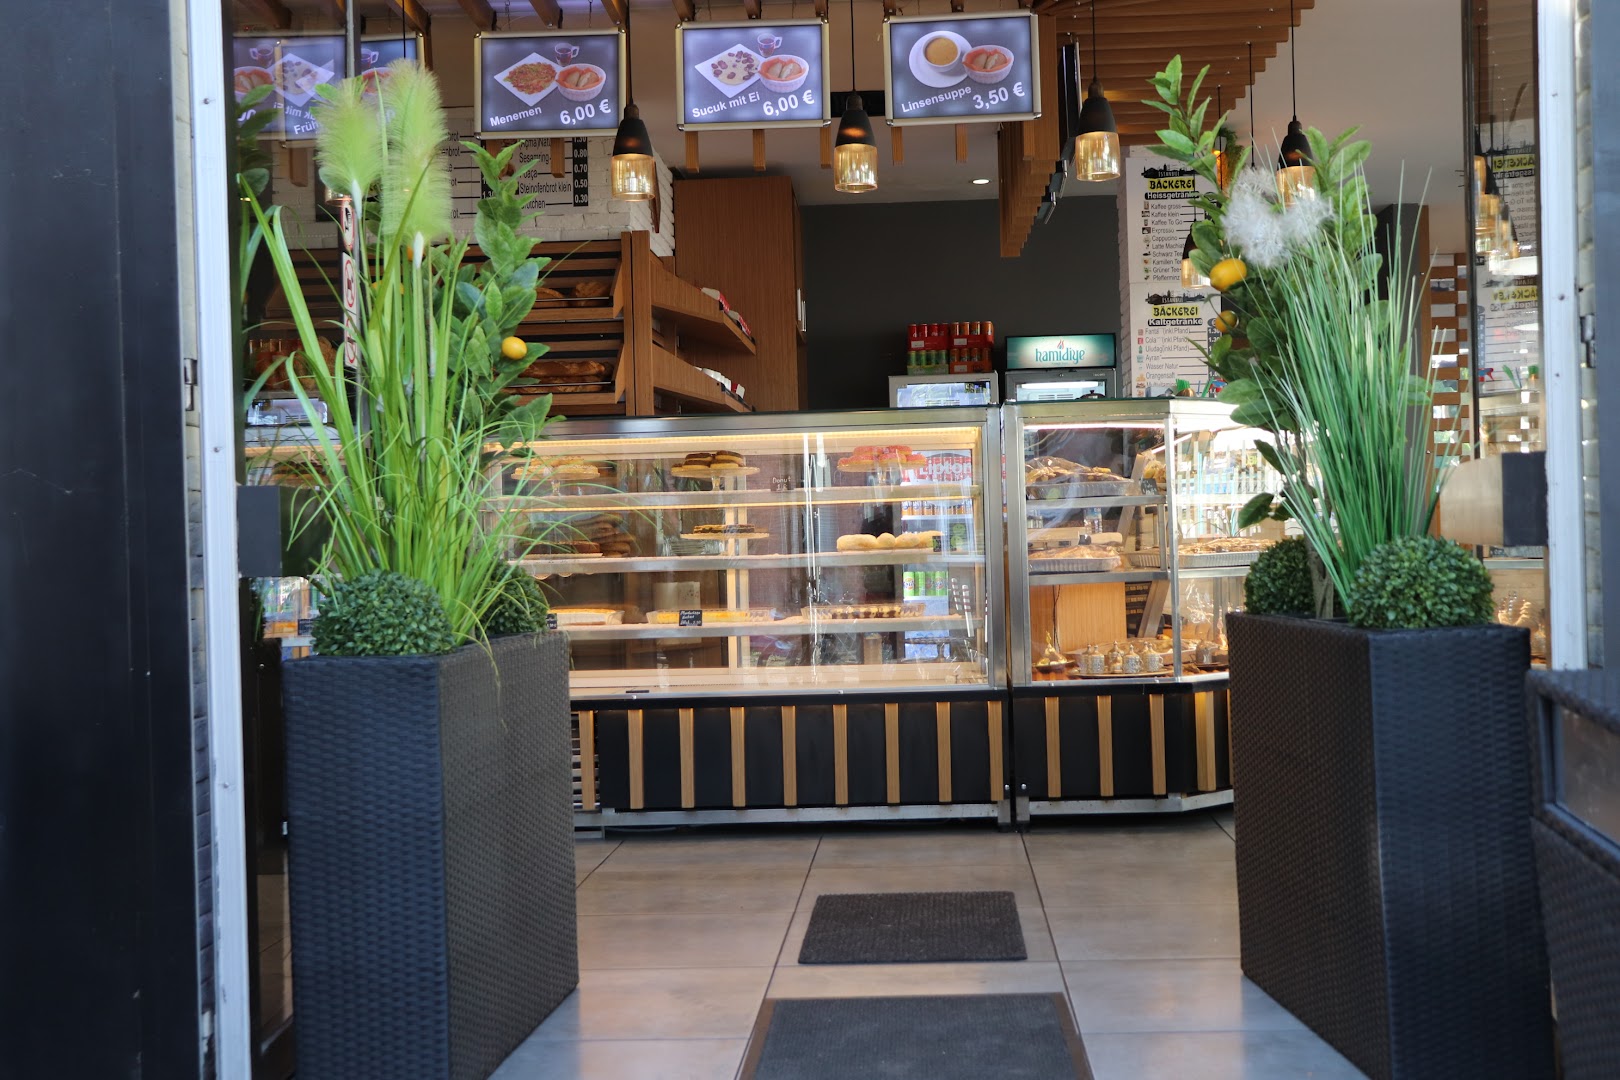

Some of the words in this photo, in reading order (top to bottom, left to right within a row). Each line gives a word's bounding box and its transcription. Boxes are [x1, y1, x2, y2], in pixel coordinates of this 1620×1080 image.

[901, 86, 972, 113] Linsensuppe
[973, 86, 1009, 109] 3,50
[1012, 82, 1025, 97] €
[692, 101, 727, 118] Sucuk
[729, 95, 747, 109] mit
[748, 91, 760, 103] Ei
[763, 94, 798, 116] 6,00
[802, 89, 815, 105] €
[490, 107, 542, 127] Menemen
[560, 103, 595, 125] 6,00
[599, 99, 612, 114] €
[574, 150, 588, 158] 0.80
[574, 165, 588, 173] 0.70
[519, 181, 557, 194] Steinofenbrot
[558, 180, 572, 193] klein
[574, 180, 588, 188] 0.50
[1149, 178, 1196, 190] BÄCKEREI
[574, 194, 588, 203] 0.30
[1168, 210, 1180, 218] klein
[1153, 266, 1170, 274] Grüner
[1153, 305, 1198, 317] BÄCKEREI
[1149, 317, 1203, 327] Kaltgetränke
[1035, 347, 1086, 365] hamidiye
[1146, 371, 1176, 380] Orangensaft
[772, 475, 791, 484] Donut
